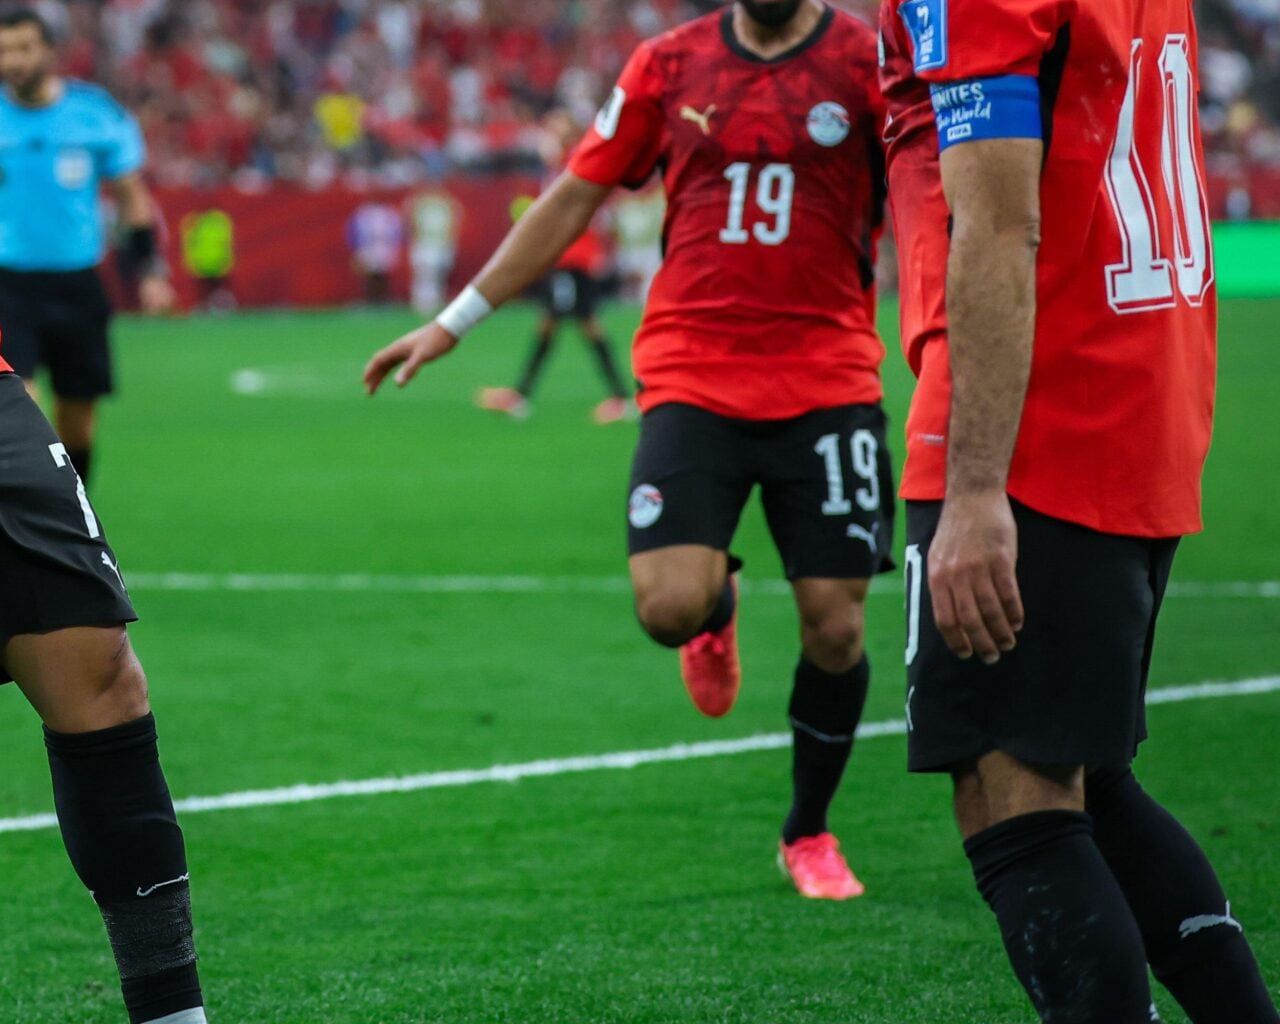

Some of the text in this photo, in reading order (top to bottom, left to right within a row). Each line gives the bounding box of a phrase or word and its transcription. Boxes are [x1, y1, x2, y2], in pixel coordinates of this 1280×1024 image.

[719, 161, 796, 246] 19
[1104, 33, 1214, 315] 10
[48, 442, 100, 539] 7
[814, 429, 880, 516] 19
